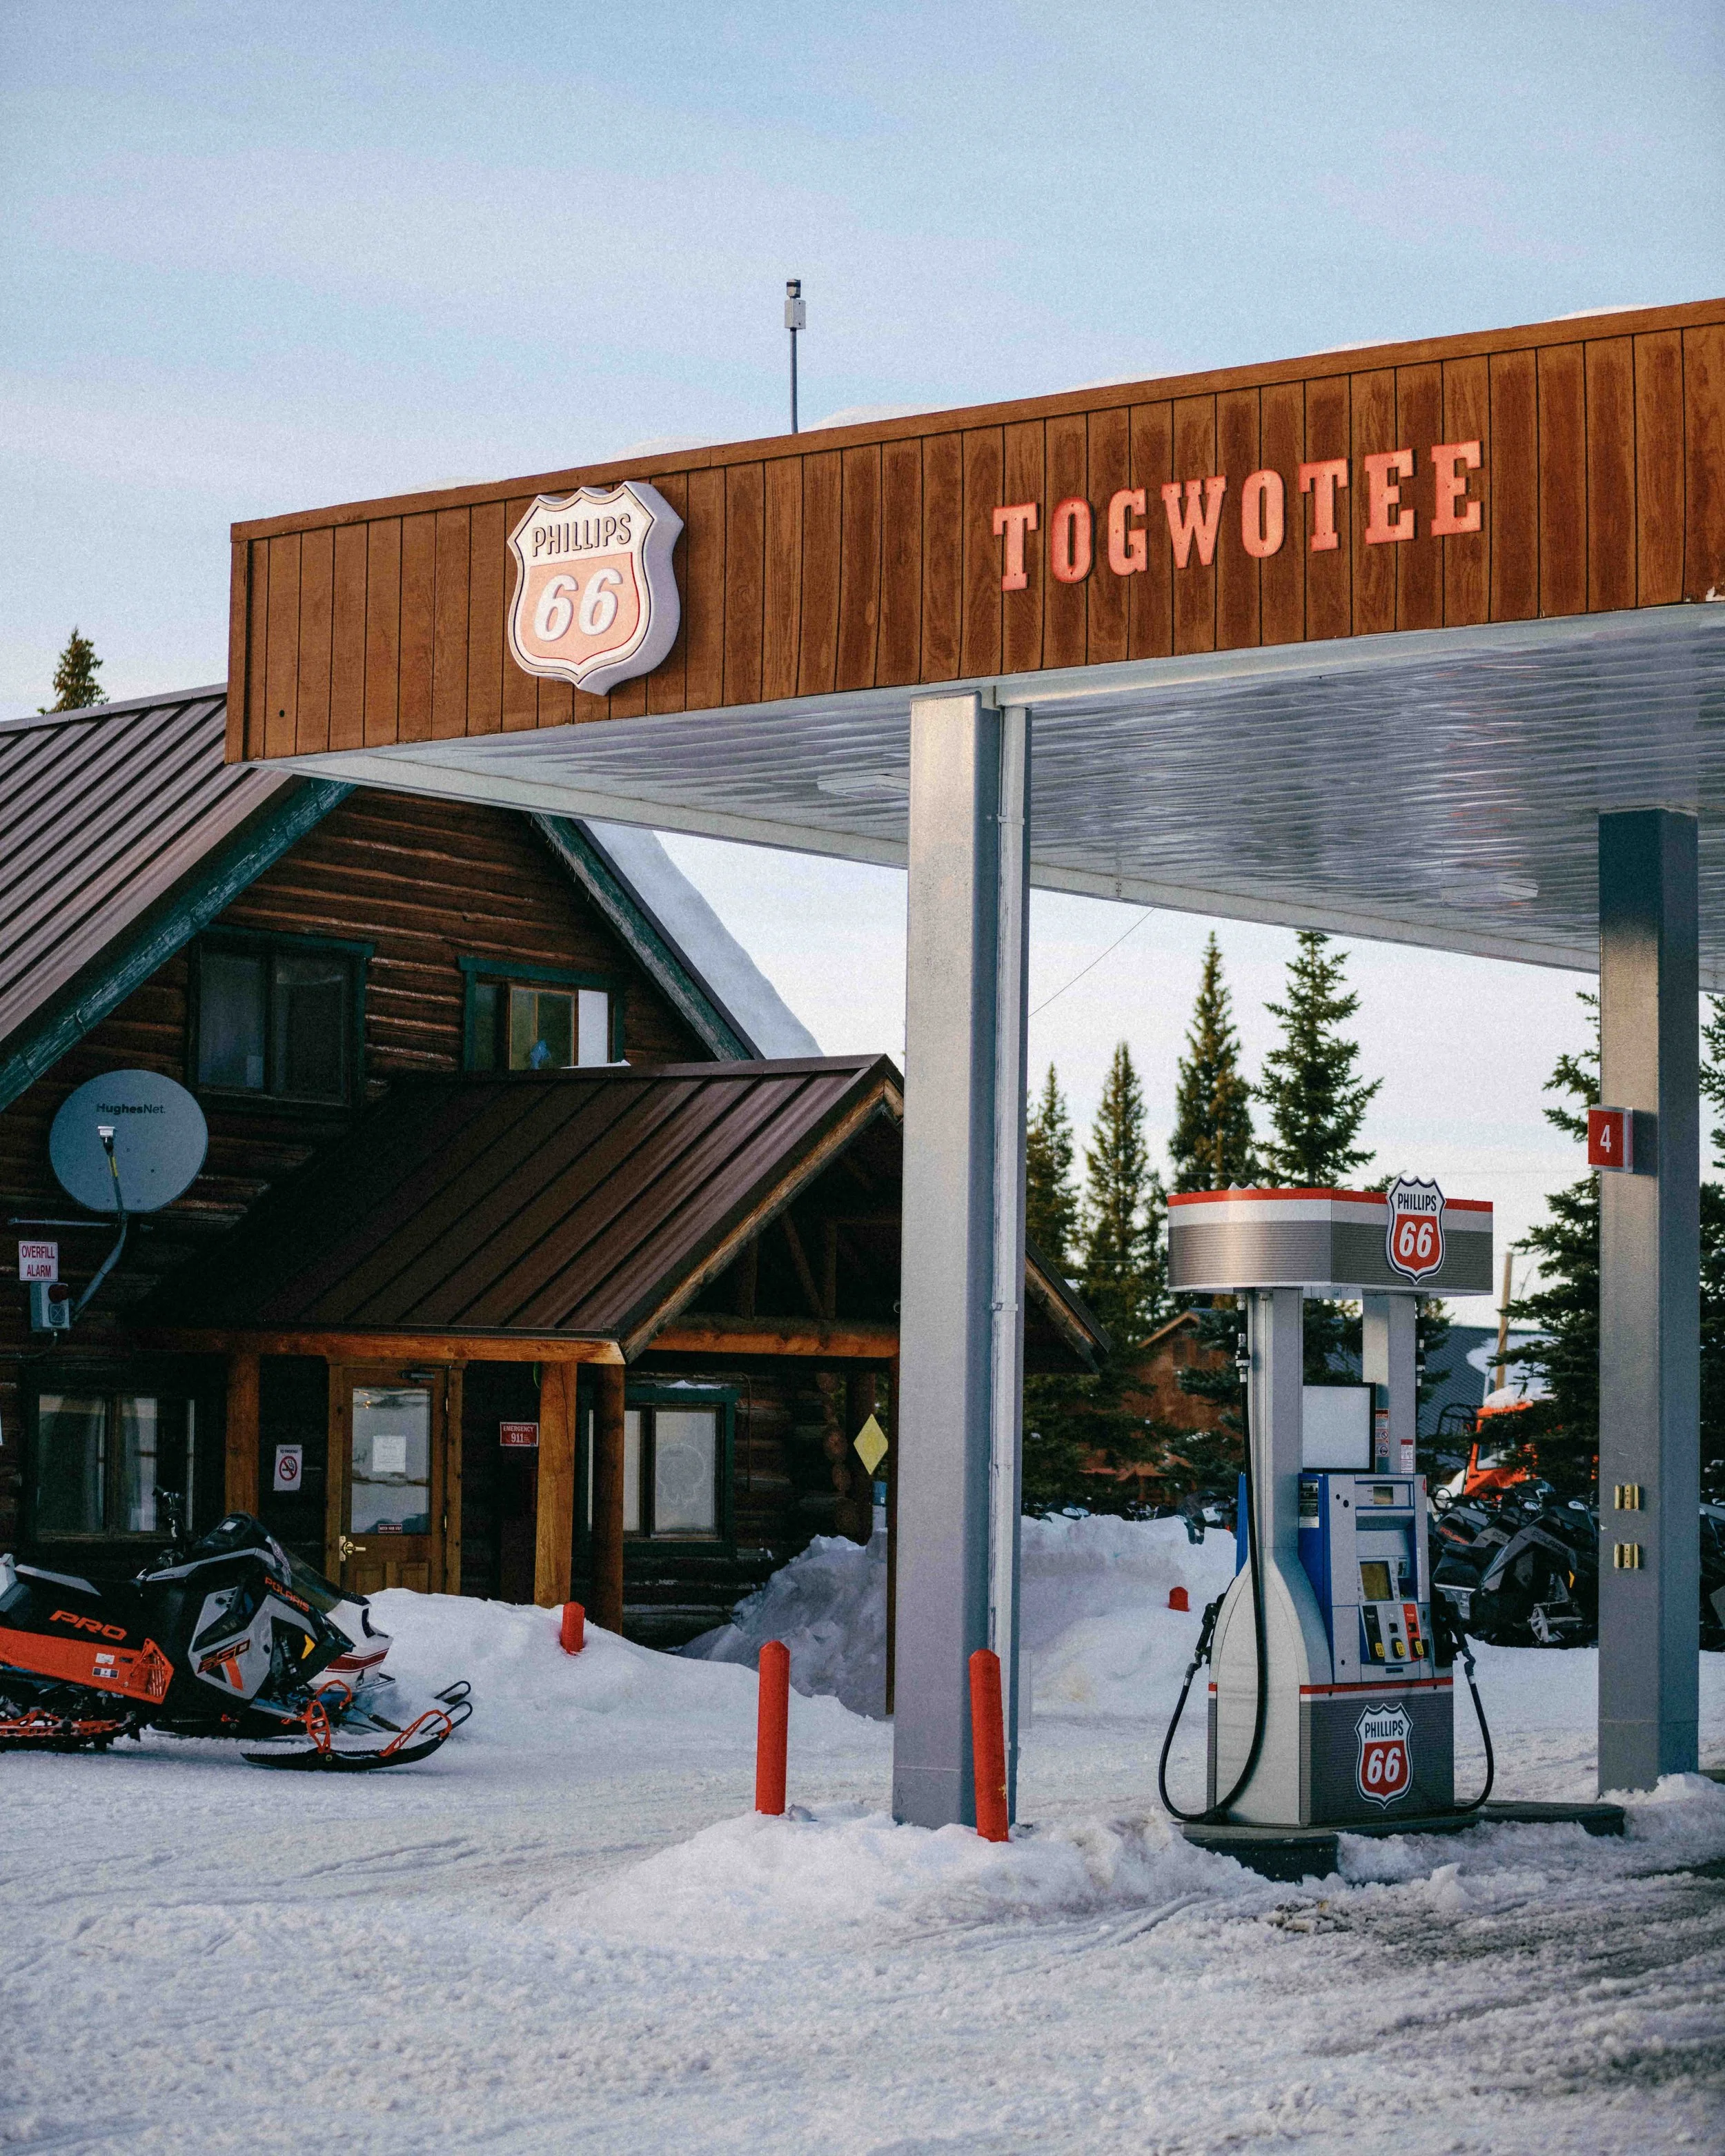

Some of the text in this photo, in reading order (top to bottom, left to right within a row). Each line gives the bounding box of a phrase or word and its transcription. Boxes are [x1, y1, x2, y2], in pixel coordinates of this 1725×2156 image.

[993, 440, 1482, 592] TOGWOTEE
[532, 513, 631, 557] PHILLIPS
[533, 567, 623, 642] 66
[1600, 1125, 1612, 1153] 4
[1398, 1193, 1437, 1211] PHILLIPS
[21, 1245, 55, 1259] OVERFILL
[1399, 1221, 1434, 1258] 66
[27, 1265, 52, 1278] ALARM
[511, 1432, 524, 1443] 911
[1422, 1478, 1426, 1494] 4
[264, 1576, 310, 1612] POLARIS
[49, 1610, 127, 1641] PRO
[1365, 1719, 1403, 1739] PHILLIPS
[1367, 1747, 1401, 1784] 66
